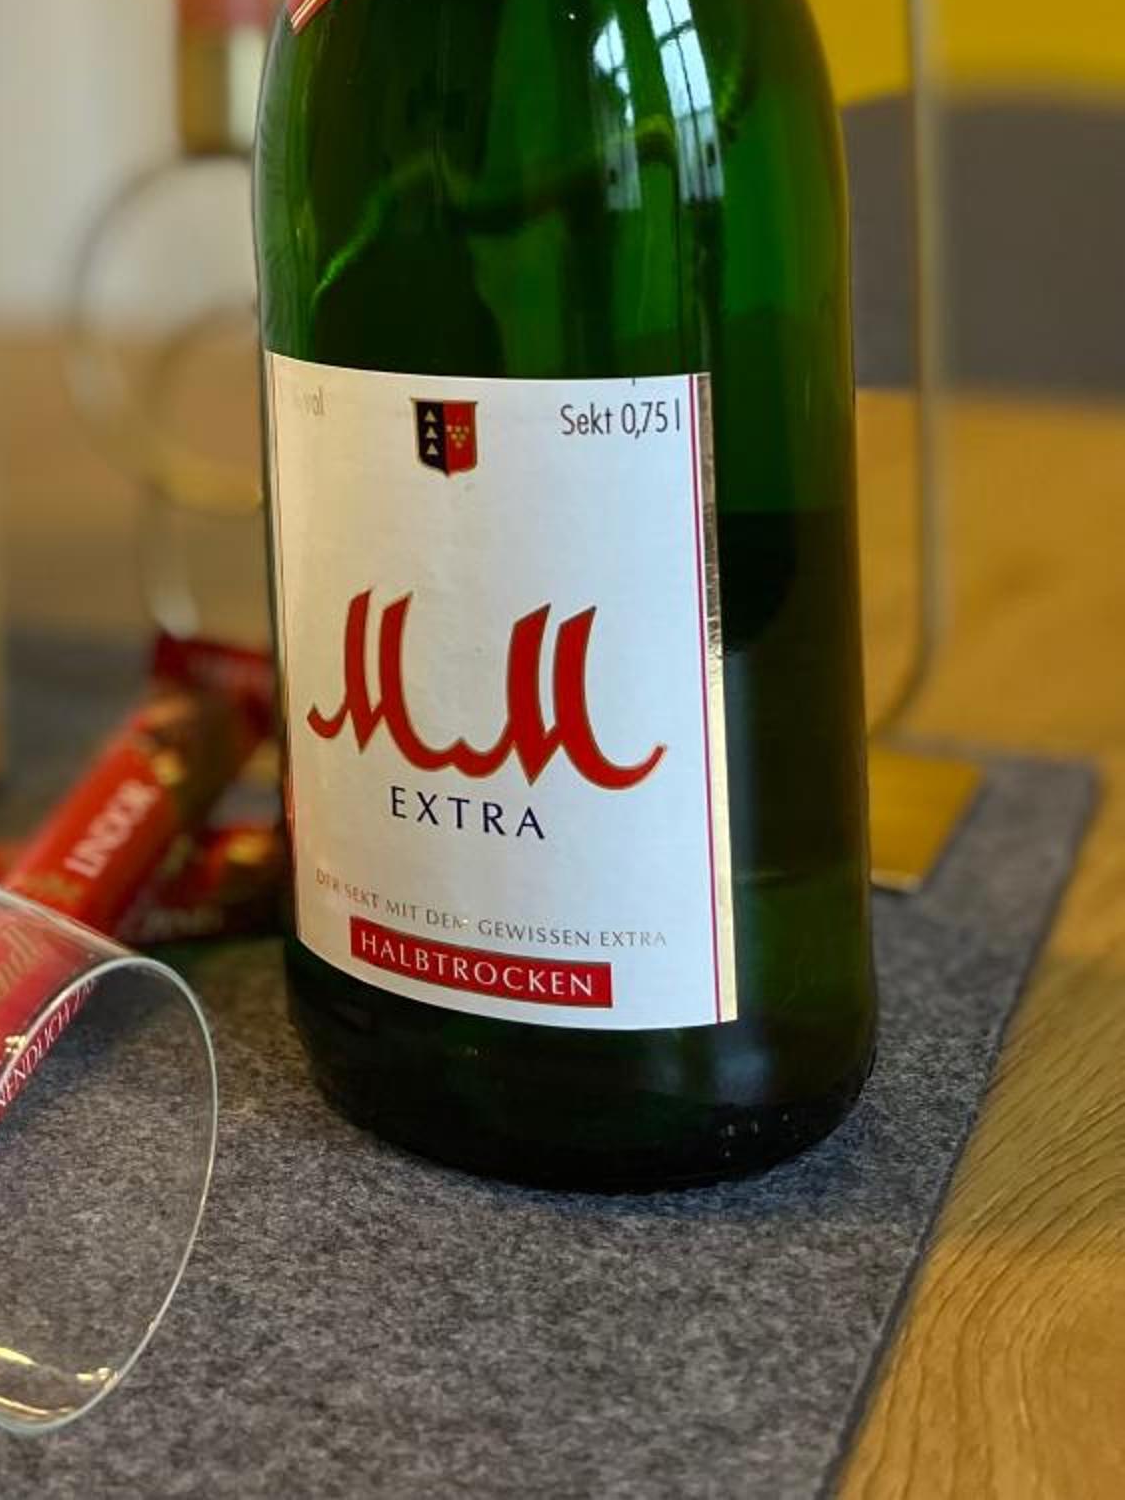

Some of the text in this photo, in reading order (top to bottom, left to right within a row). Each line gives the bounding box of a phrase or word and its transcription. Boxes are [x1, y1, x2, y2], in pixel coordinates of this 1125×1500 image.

[560, 401, 614, 436] Sekt
[620, 401, 668, 440] 0,75
[390, 786, 547, 841] EXTRA
[344, 883, 380, 910] SEKT
[385, 898, 422, 922] MIT
[477, 918, 592, 947] GEWISSEN
[599, 930, 668, 948] EXTRA
[360, 930, 594, 997] HALBTROCKEN
